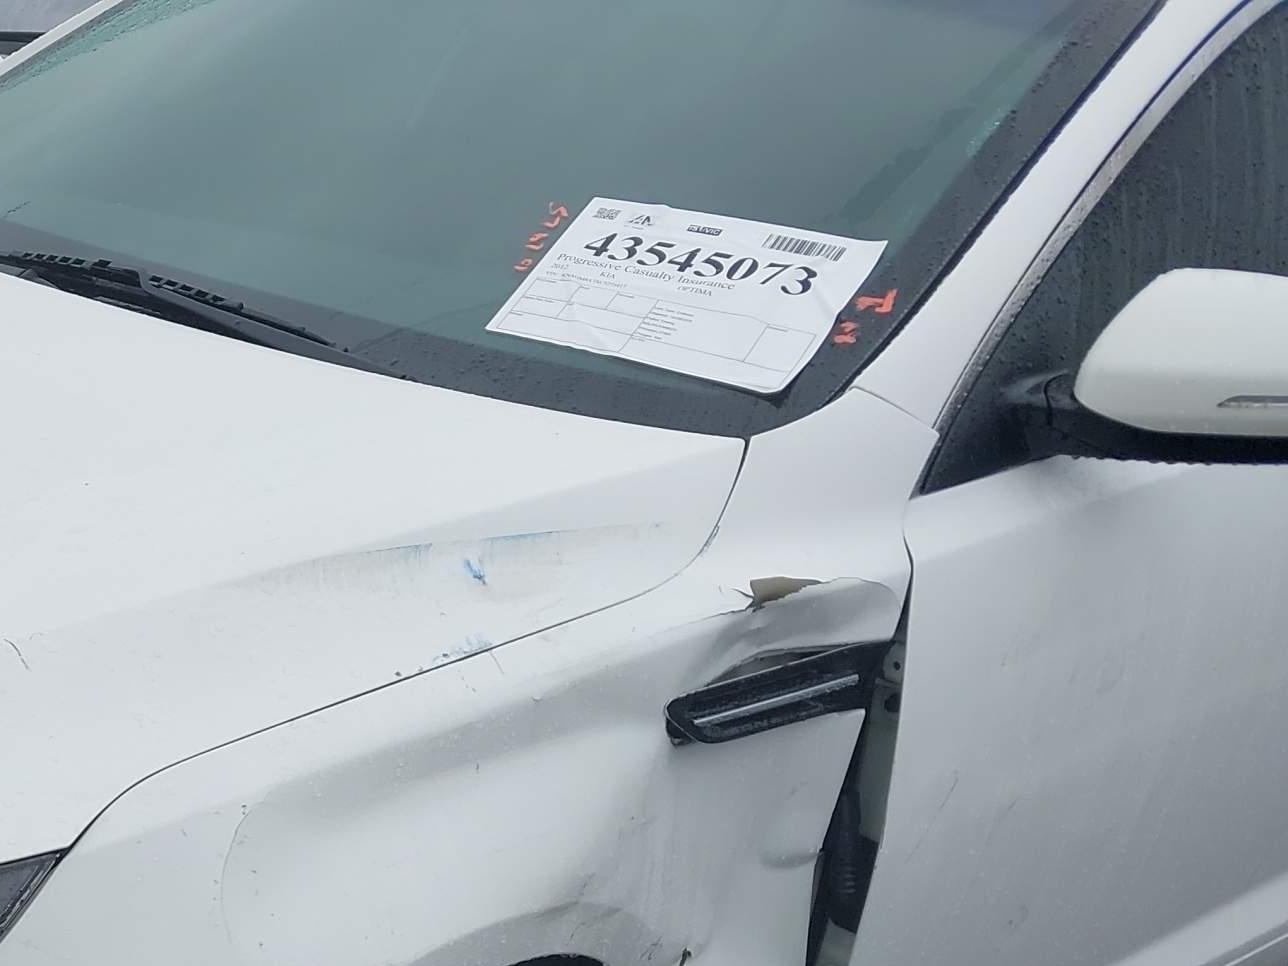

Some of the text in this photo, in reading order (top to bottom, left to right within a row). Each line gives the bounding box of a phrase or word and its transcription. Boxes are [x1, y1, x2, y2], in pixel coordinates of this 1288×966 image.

[556, 253, 622, 271] Progressive
[623, 264, 676, 281] Casualty
[678, 273, 735, 290] Insurance
[584, 231, 817, 296] 43545073
[677, 284, 713, 296] OPTIMA
